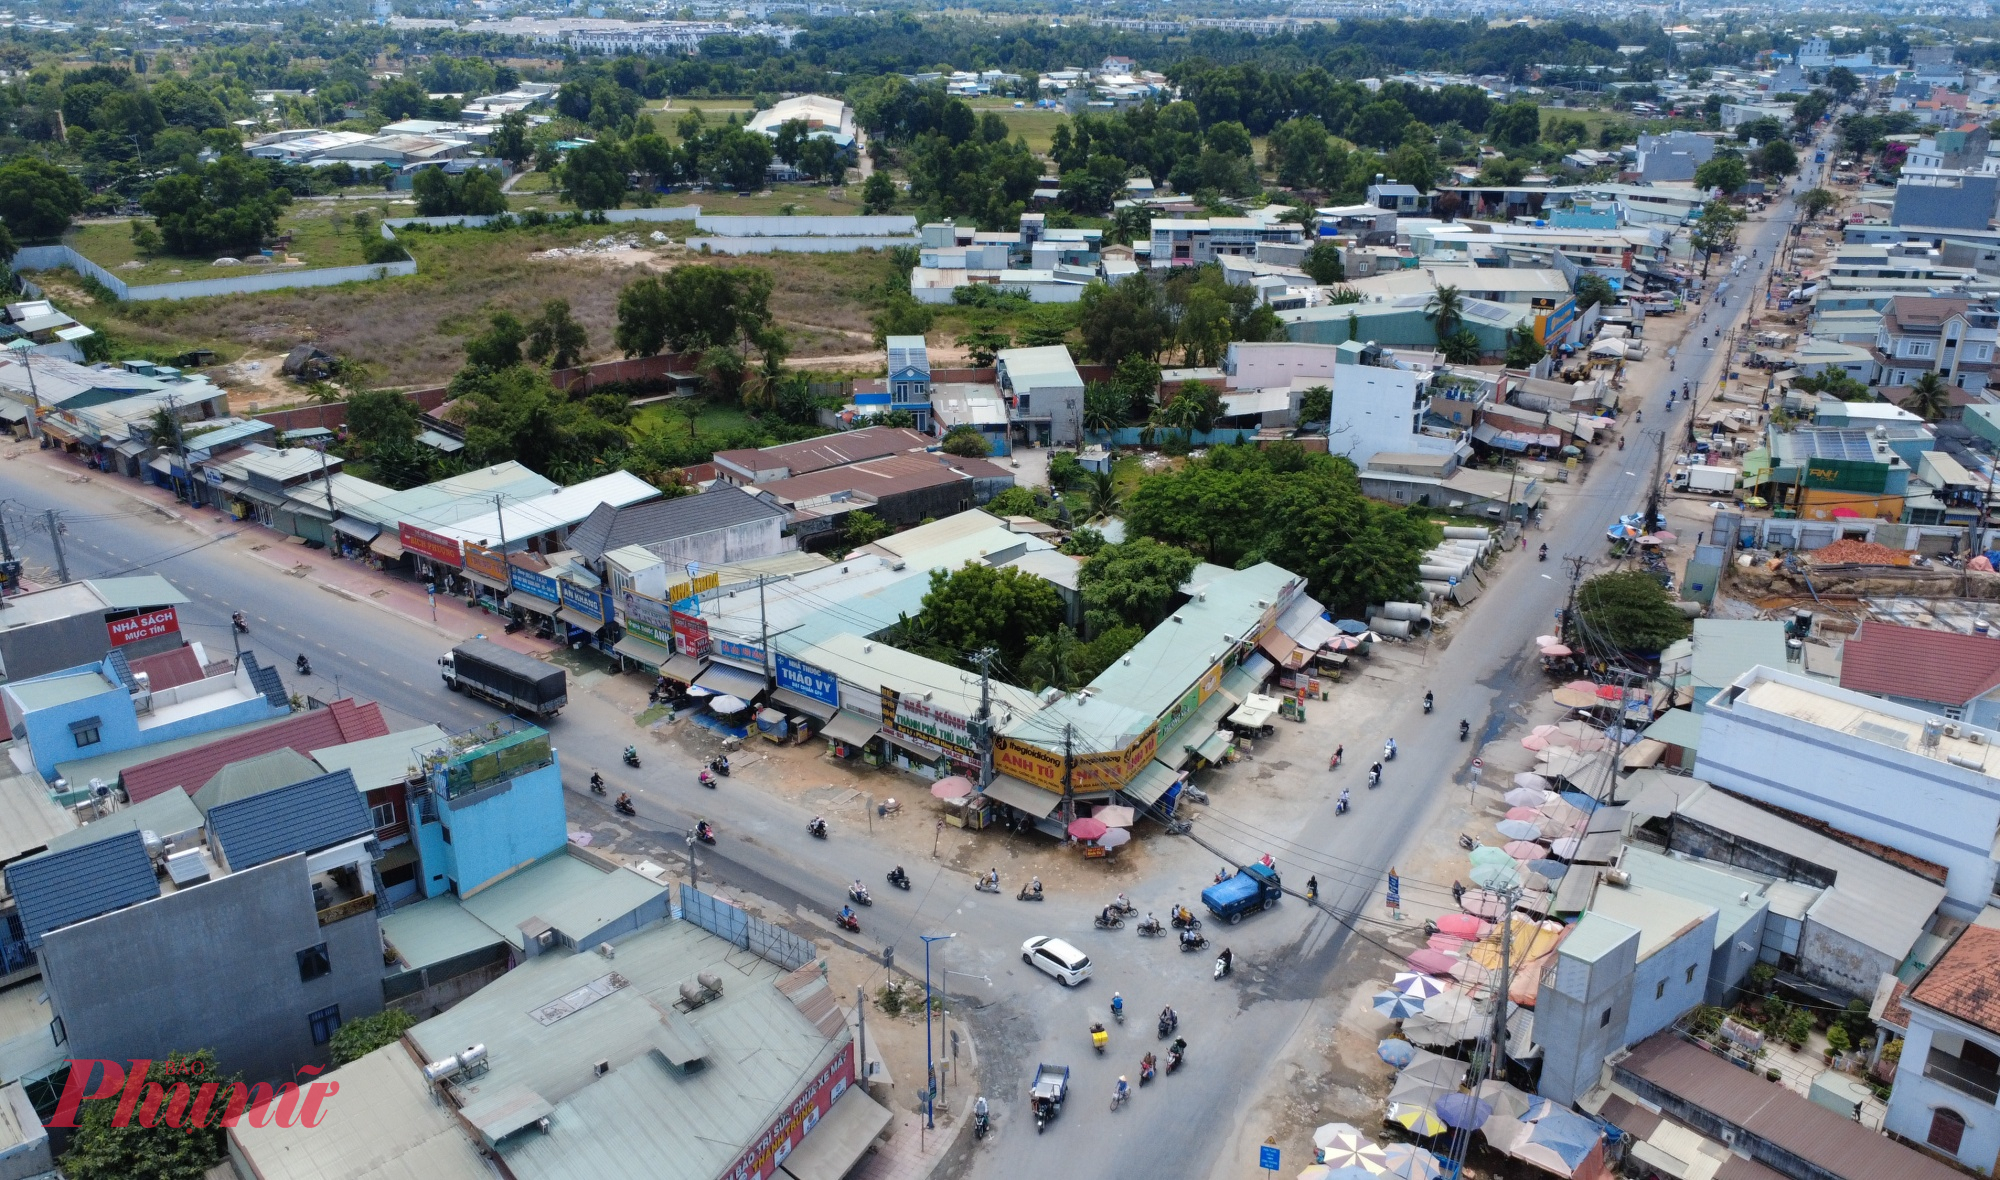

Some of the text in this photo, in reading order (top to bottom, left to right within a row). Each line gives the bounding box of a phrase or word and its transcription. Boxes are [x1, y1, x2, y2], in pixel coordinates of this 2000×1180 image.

[113, 612, 173, 633] NHÀ SÁCH
[125, 624, 166, 641] MỰC TÍM
[782, 667, 813, 687] THẢO
[815, 679, 831, 693] VY
[896, 714, 973, 749] THÀNH PHỐ THỦ ĐỨC
[934, 711, 966, 731] KÍNH
[1002, 752, 1033, 772] ANH
[1037, 764, 1054, 779] TÚ
[1009, 741, 1061, 768] thegioididong
[735, 1152, 755, 1179] BẢO
[757, 1131, 772, 1154] TRÌ
[774, 1113, 791, 1137] SỬA
[793, 1088, 817, 1115] CHỮA
[818, 1070, 830, 1090] XE
[830, 1050, 847, 1075] MÁY
[753, 1134, 784, 1173] THANH
[785, 1101, 815, 1137] TRUNG
